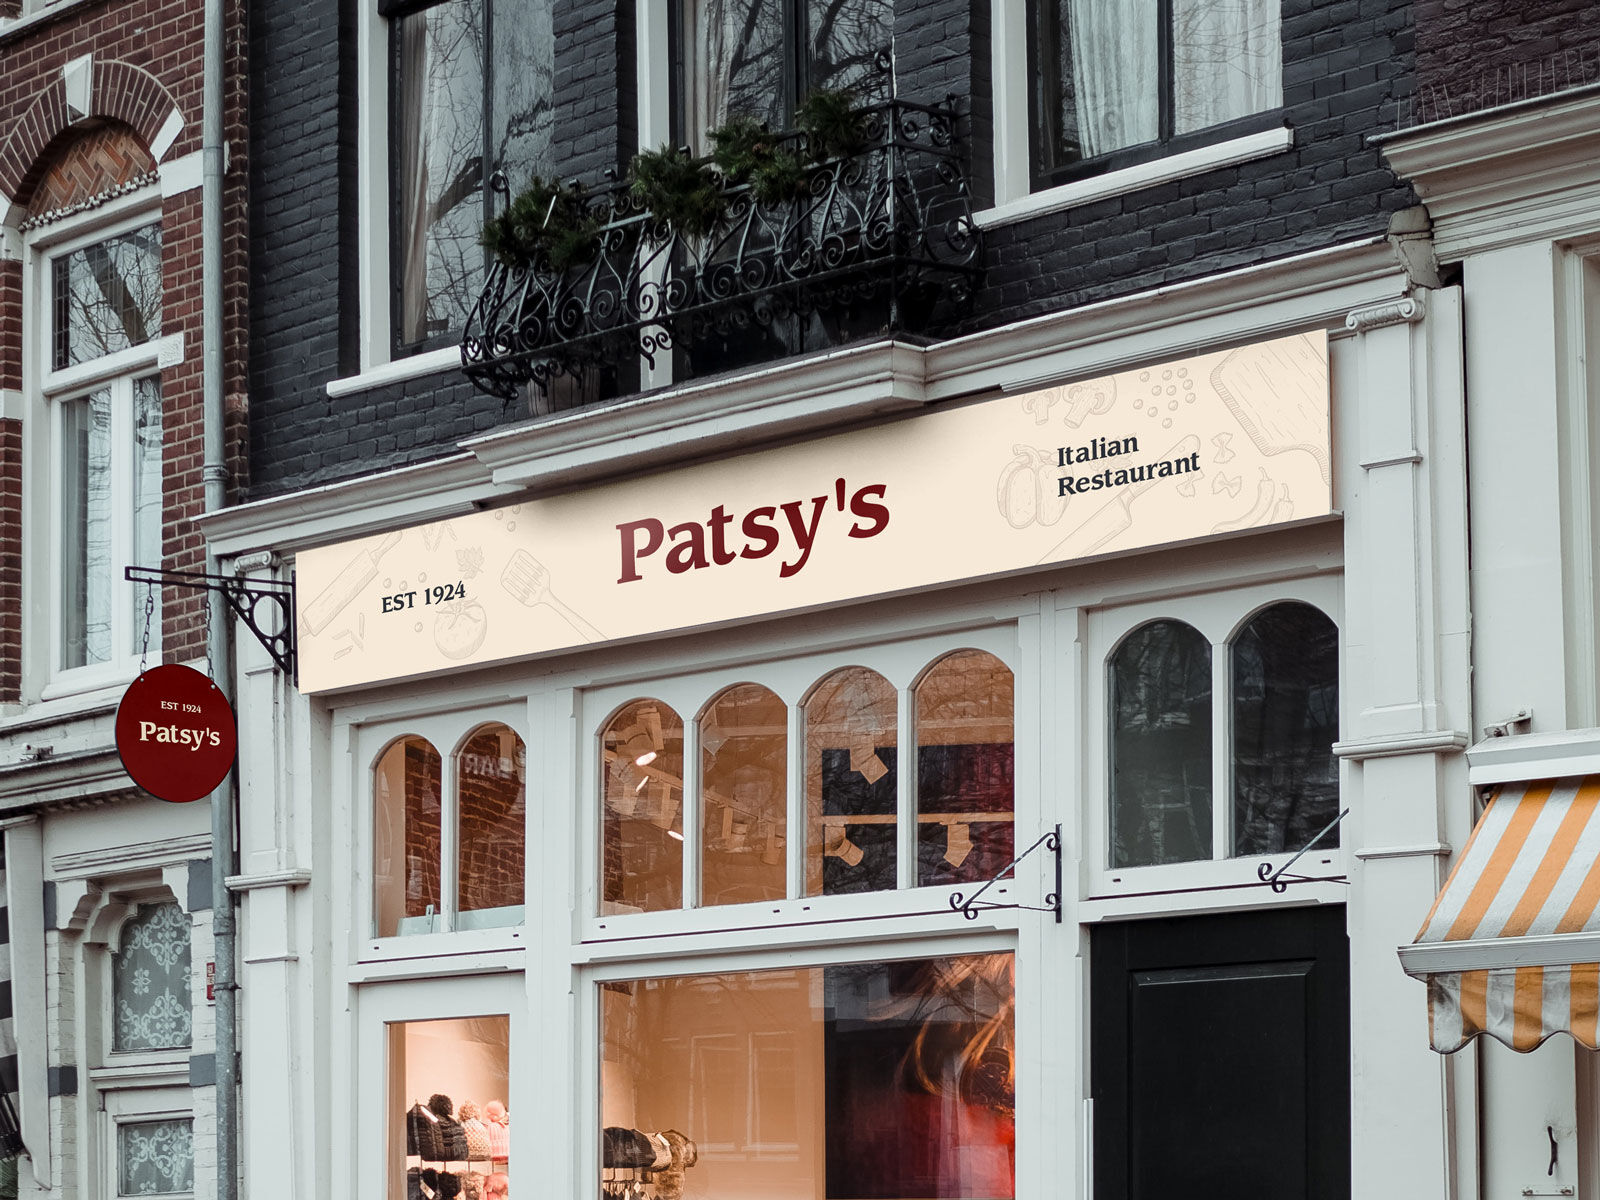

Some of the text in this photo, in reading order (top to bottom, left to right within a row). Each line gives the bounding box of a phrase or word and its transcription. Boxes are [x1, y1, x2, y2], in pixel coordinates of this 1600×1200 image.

[1057, 436, 1139, 468] Italian
[1058, 451, 1201, 498] Restaurant
[615, 477, 890, 585] Patsy's
[381, 580, 466, 614] EST 1924
[160, 700, 202, 713] EST 1924
[139, 720, 221, 752] Patsy's
